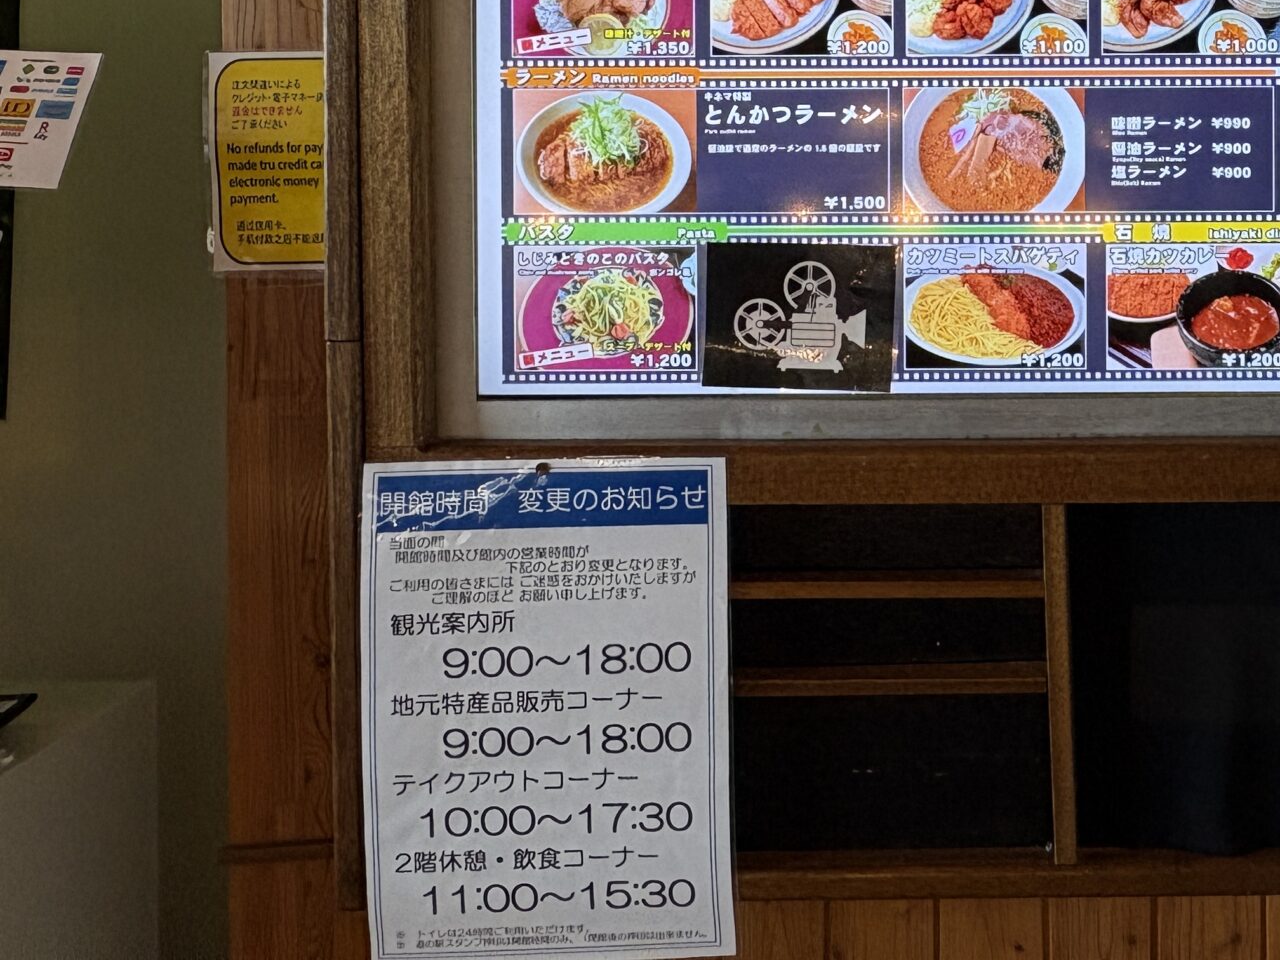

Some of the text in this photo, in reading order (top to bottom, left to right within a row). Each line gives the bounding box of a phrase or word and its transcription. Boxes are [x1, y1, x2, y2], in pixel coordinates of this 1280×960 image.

[626, 41, 690, 55] ¥1,350
[827, 40, 889, 55] ¥1,200
[1022, 40, 1086, 55] ¥1,100
[1216, 39, 1278, 53] ¥1,000
[516, 69, 587, 86] ラーメン
[592, 73, 695, 84] Ramen noodles
[705, 104, 882, 125] とんかつラーメン
[1111, 116, 1251, 130] 味噌ラーメン ¥990
[227, 141, 302, 154] No refunds for
[1111, 141, 1252, 156] 醤油ラーメン ¥900
[228, 158, 308, 171] made tru credit
[1111, 165, 1252, 179] 塩ラーメン ¥900
[229, 175, 320, 189] electronic money
[230, 193, 279, 207] payment.
[824, 196, 886, 210] ¥1,500
[518, 224, 576, 240] パスタ
[677, 228, 716, 240] Pasta
[518, 252, 669, 266] しじみときのこのパスタ
[907, 246, 1079, 265] カツミートスパゲティ
[630, 353, 692, 368] ¥1,200
[1021, 352, 1085, 368] ¥1,200
[379, 484, 707, 516] 開館時間 変更のお知らせ
[389, 535, 445, 550] 当面の間
[505, 557, 688, 575] 下記のとおり変更となります。
[389, 570, 697, 593] ご利用の皆さまには ご迷惑をおかけいたしますが
[431, 586, 647, 605] ご理解のほど お願い申し上げます。
[391, 609, 516, 637] 観光案内所
[391, 688, 663, 717] 地元特産品販売コーナー
[392, 768, 639, 796] テイクアウトコーナー
[395, 846, 660, 875] 2階休憩・飲食コーナー
